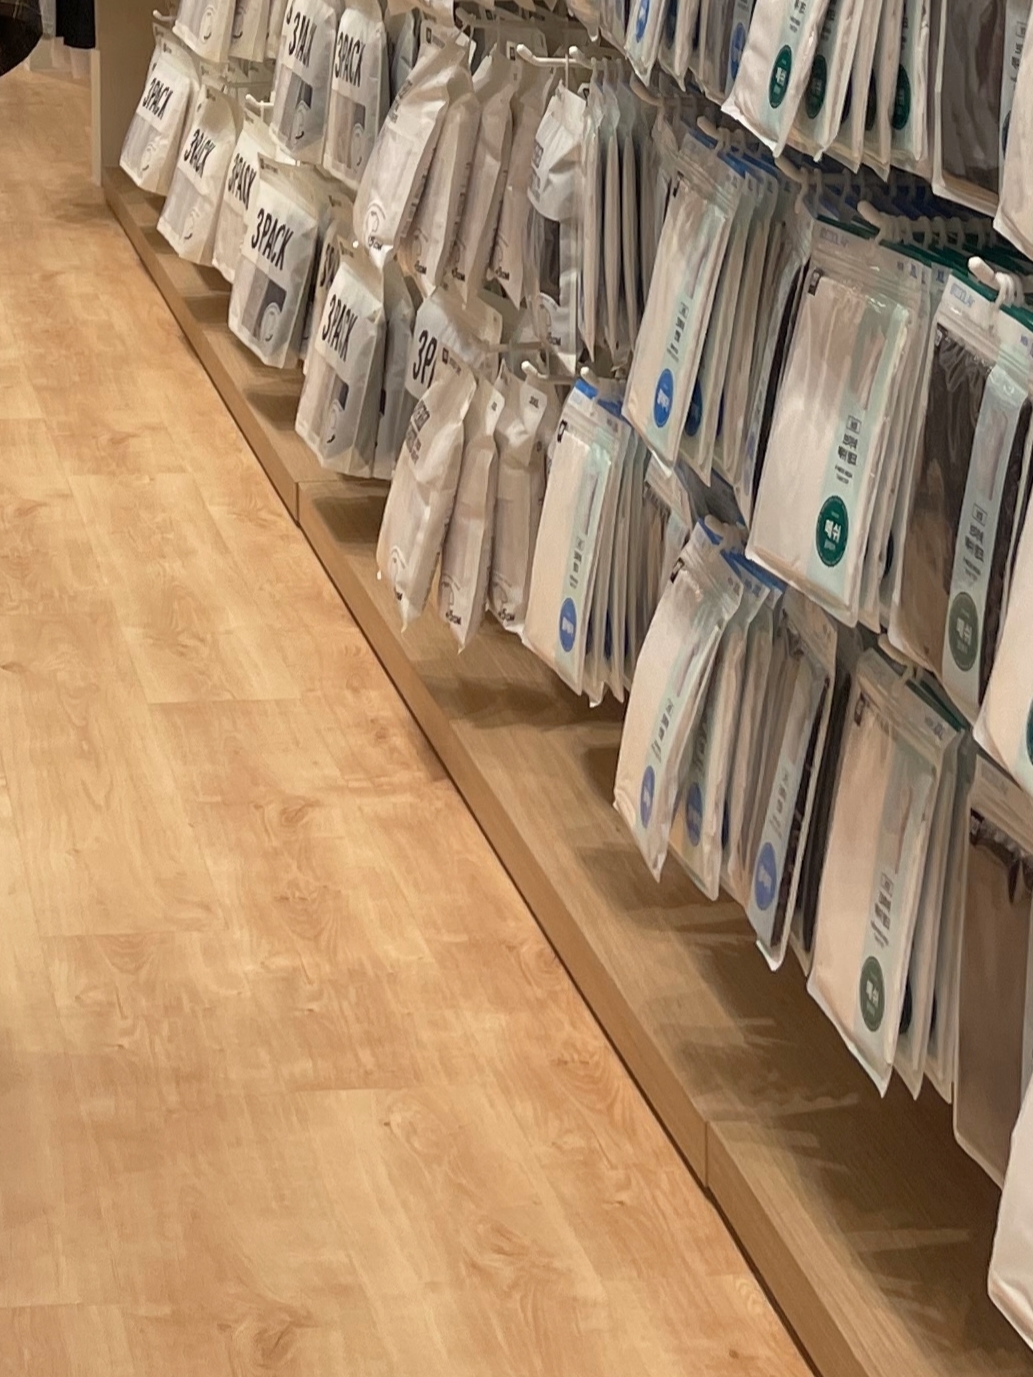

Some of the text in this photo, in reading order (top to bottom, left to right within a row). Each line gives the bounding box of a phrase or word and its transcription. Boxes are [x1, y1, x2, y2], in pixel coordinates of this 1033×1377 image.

[334, 32, 366, 88] 3PACK
[142, 78, 174, 120] 3PACK
[184, 129, 217, 179] 3PACK
[227, 153, 258, 211] 3PACK
[251, 208, 294, 271] 3PACK
[321, 294, 358, 362] 3PACK
